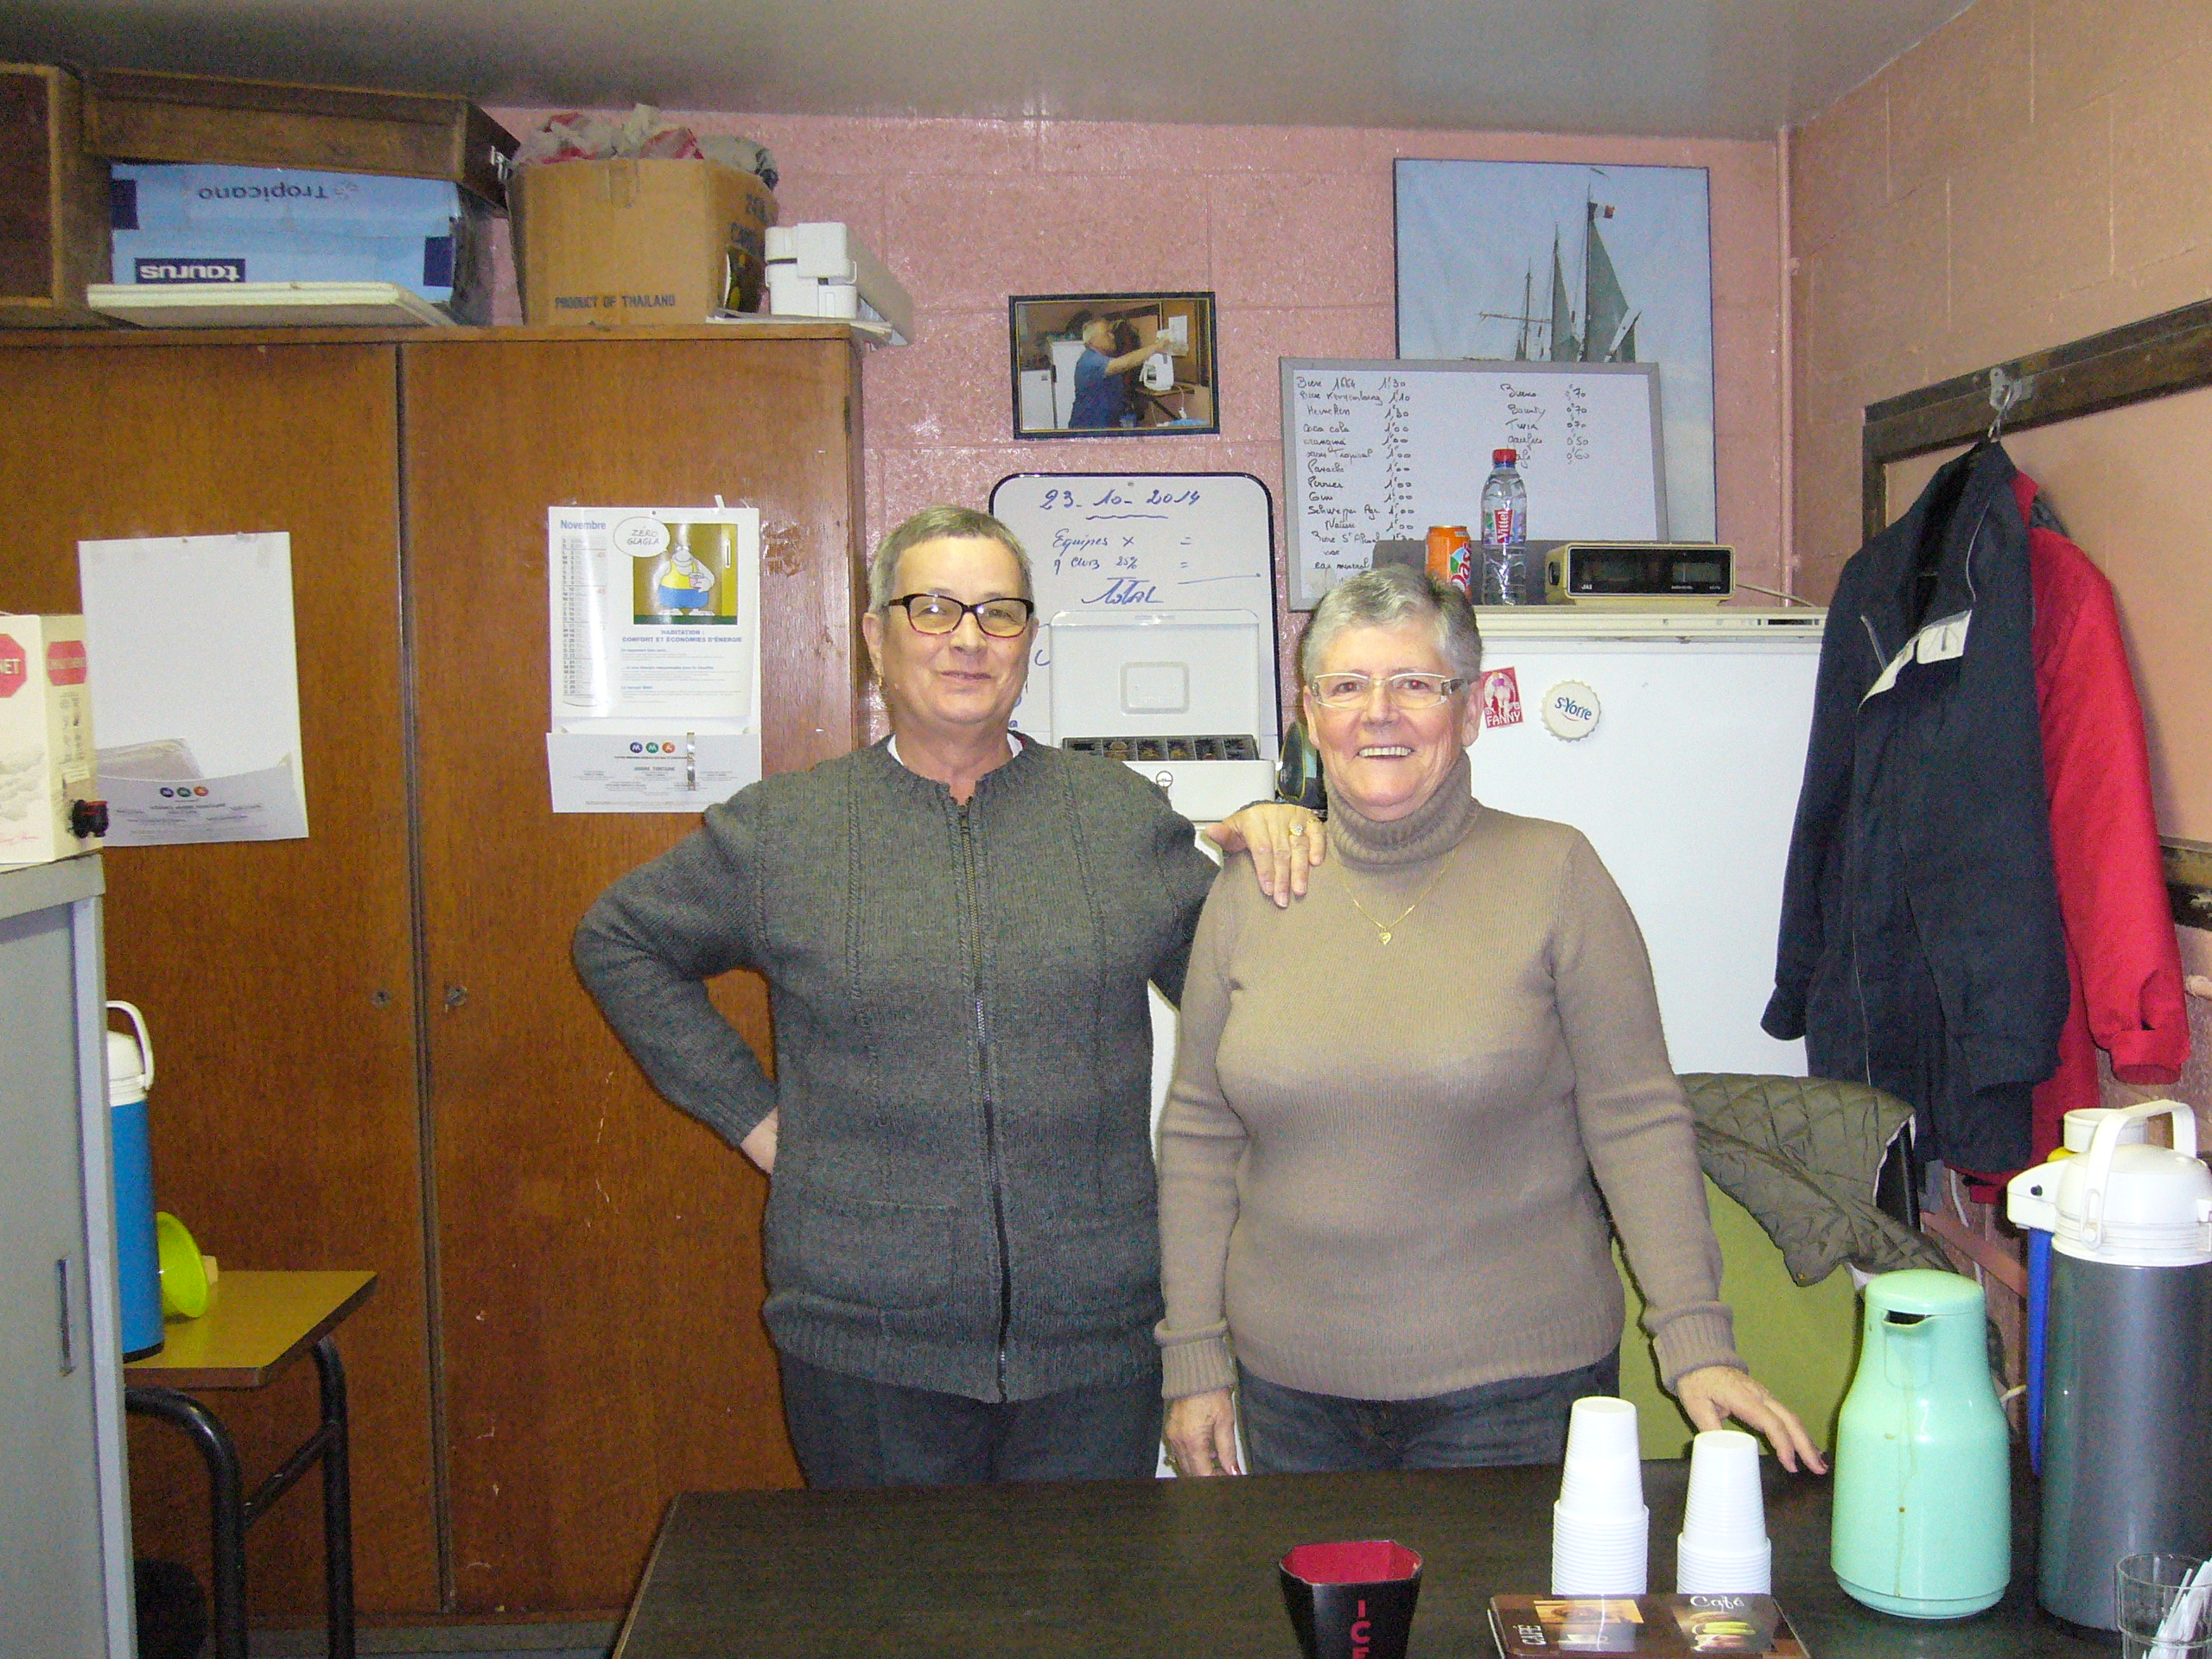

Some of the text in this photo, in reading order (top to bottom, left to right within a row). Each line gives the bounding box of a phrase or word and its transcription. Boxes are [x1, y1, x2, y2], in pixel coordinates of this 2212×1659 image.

[139, 264, 240, 281] taurus
[555, 295, 676, 308] PRODUCT OF THAILAND
[561, 519, 607, 530] Novembre
[1497, 512, 1510, 539] Vittel
[1486, 711, 1522, 727] FANNY
